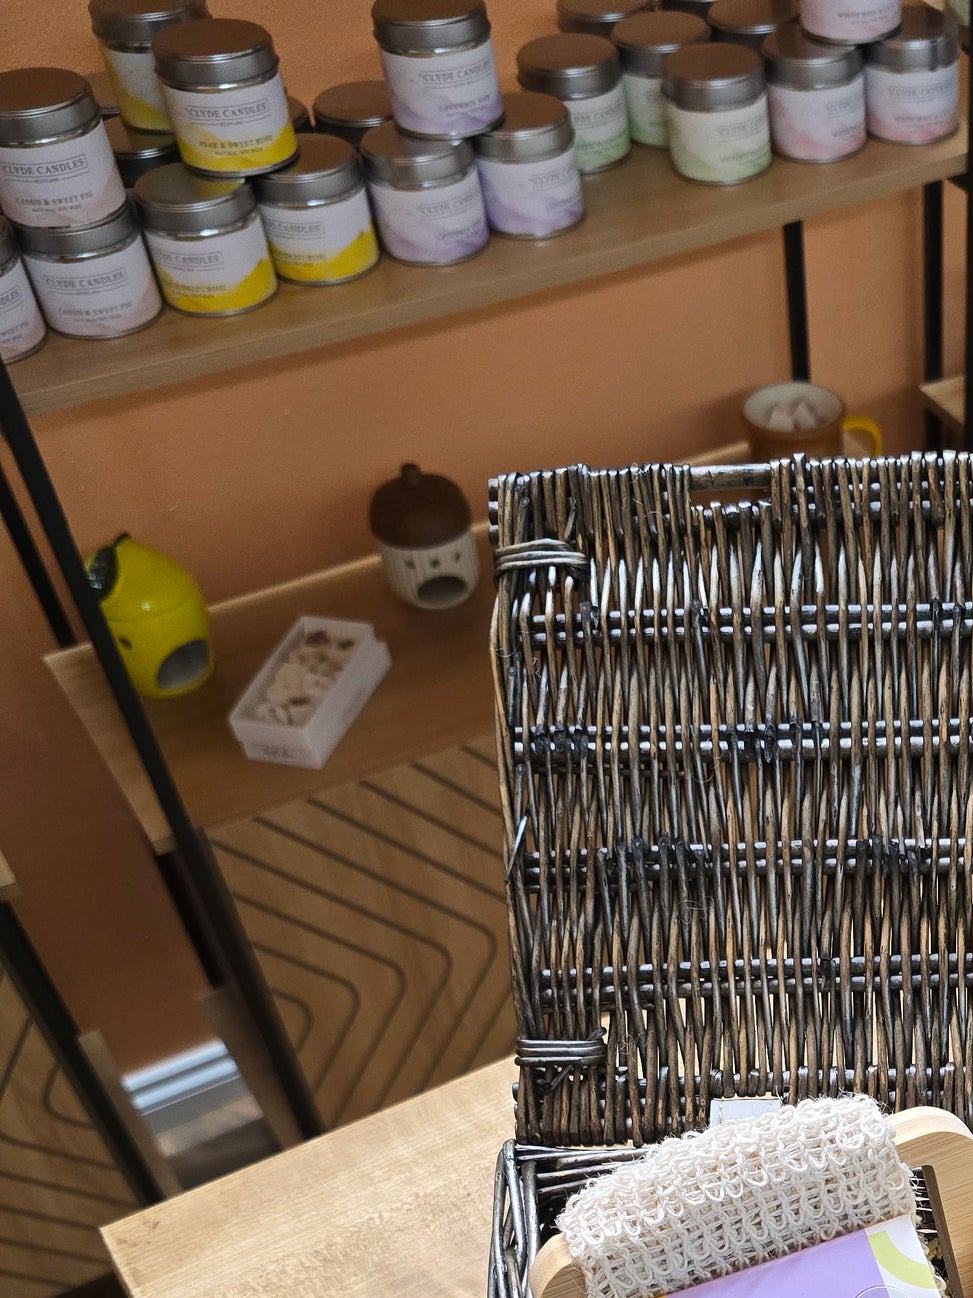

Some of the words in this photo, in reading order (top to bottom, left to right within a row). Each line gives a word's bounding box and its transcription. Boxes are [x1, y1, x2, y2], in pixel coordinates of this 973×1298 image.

[222, 103, 267, 118] CANDLES
[2, 165, 34, 175] CLYDE
[36, 158, 85, 175] CANDLES
